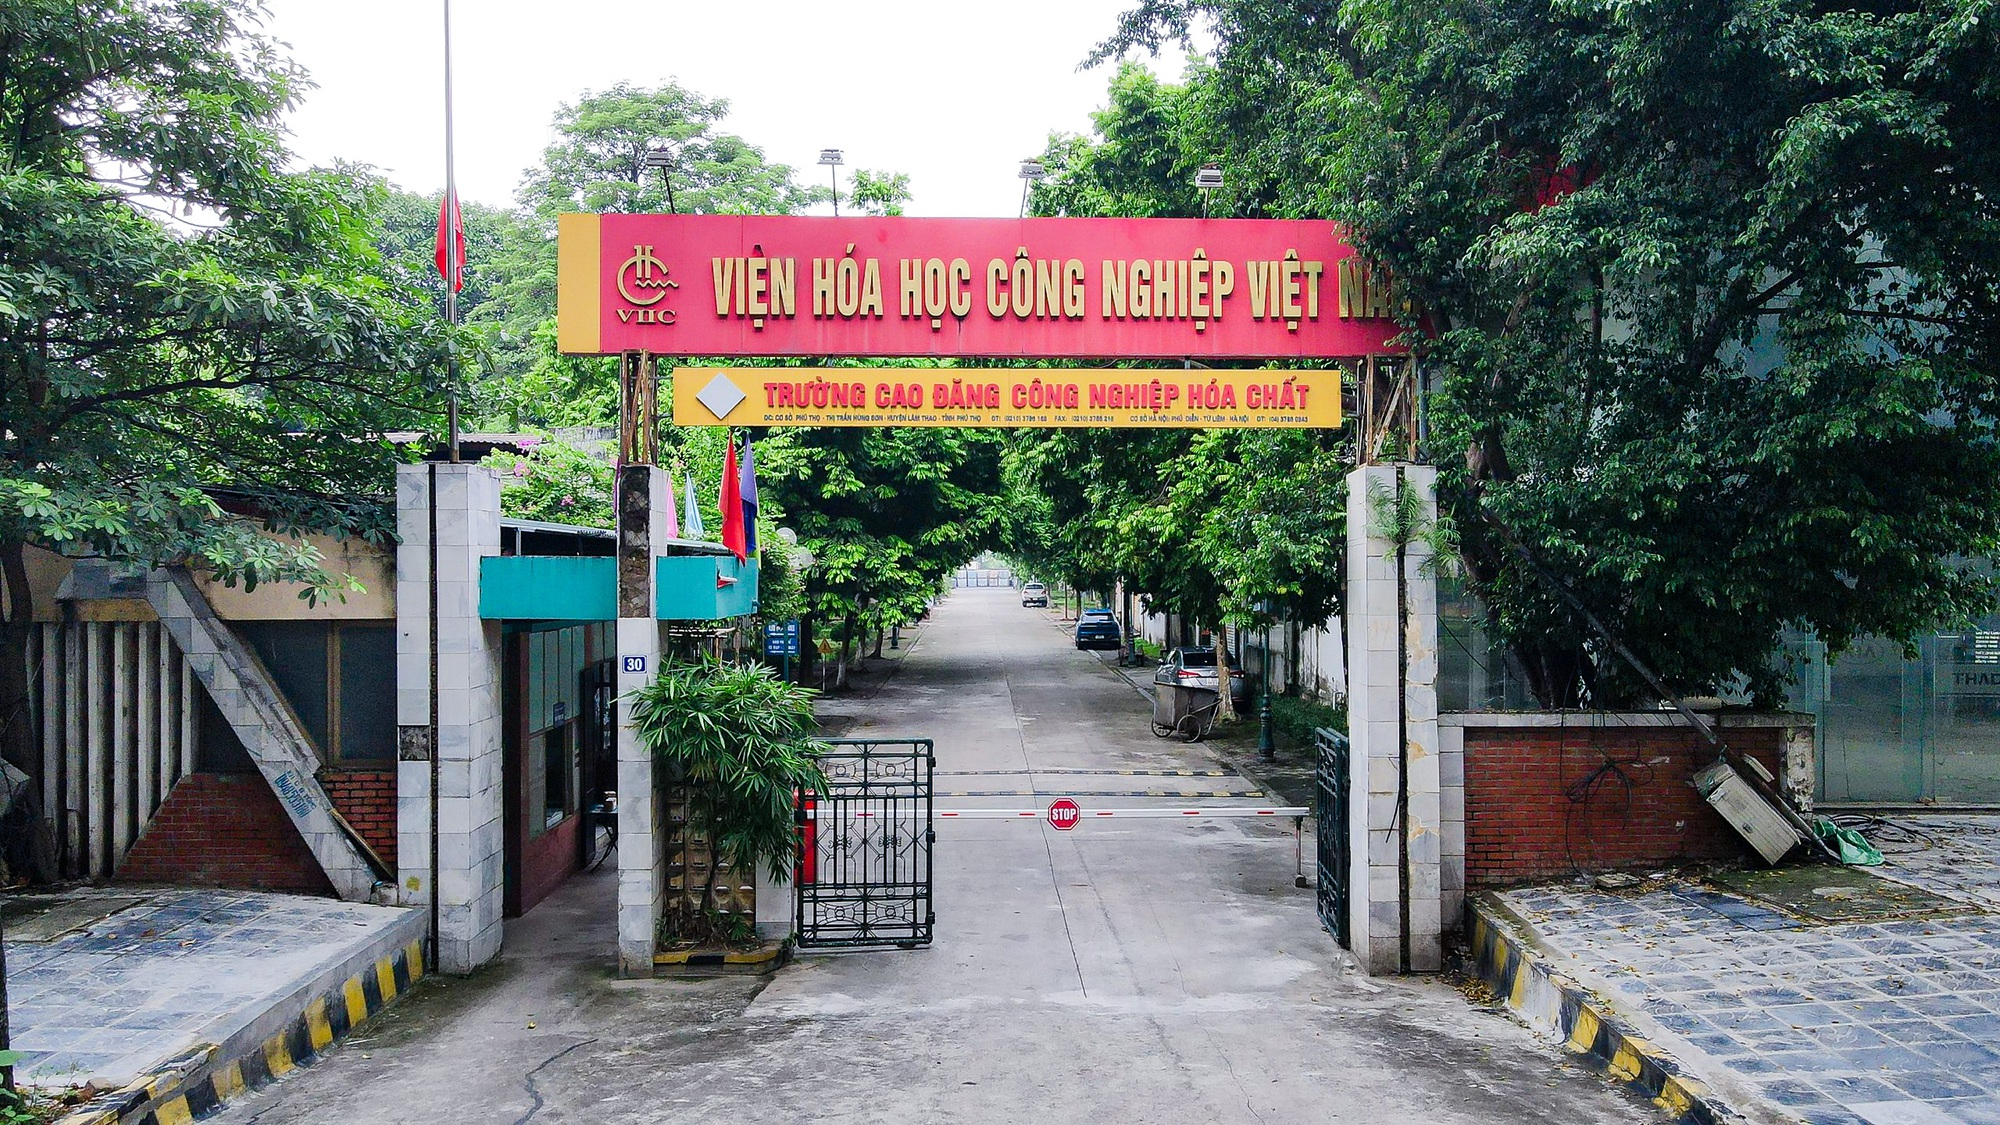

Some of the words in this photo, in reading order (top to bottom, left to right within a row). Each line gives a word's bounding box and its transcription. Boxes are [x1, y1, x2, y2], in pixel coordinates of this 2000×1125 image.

[712, 244, 796, 329] VIỆN
[813, 244, 884, 318] HÓA
[900, 257, 972, 329] HỌC
[986, 246, 1085, 318] CÔNG
[1102, 248, 1234, 330] NGHIỆP
[1246, 248, 1322, 331] VIỆT
[764, 376, 866, 408] TRƯỜNG
[875, 383, 924, 408] CAO
[1012, 378, 1079, 409] CÔNG
[1089, 378, 1180, 413] NGHIỆP
[1188, 379, 1236, 409] HÓA
[1246, 375, 1310, 409] CHẤT
[796, 413, 808, 422] PHÚ
[808, 414, 821, 422] THỌ
[626, 658, 643, 670] 30
[1052, 808, 1076, 820] STOP
